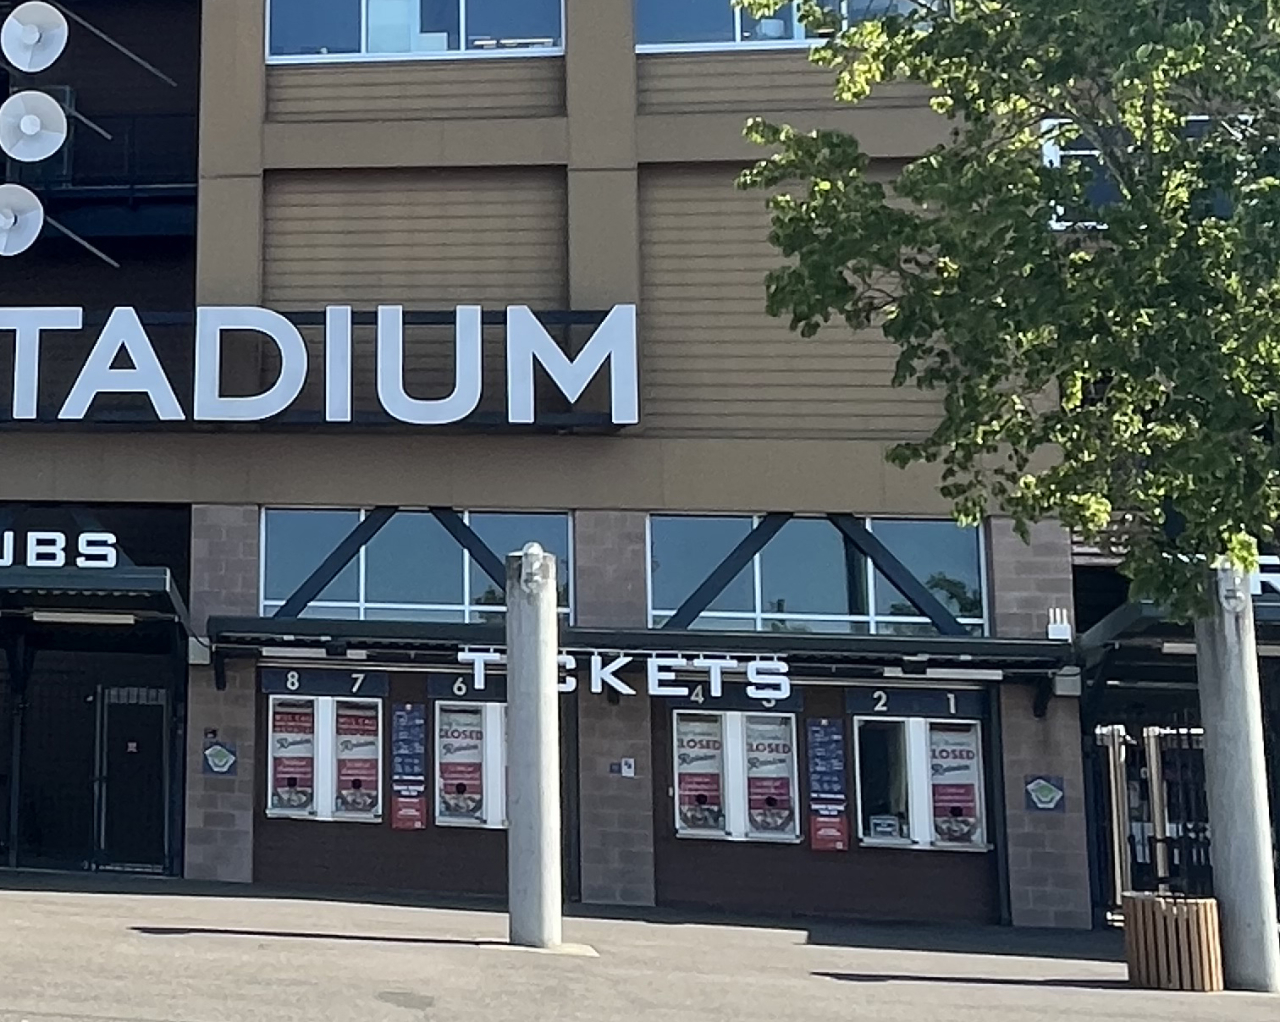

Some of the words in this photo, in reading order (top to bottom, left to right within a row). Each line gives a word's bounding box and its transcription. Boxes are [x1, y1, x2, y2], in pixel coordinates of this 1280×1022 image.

[286, 671, 299, 690] 8
[351, 673, 365, 693] 7
[457, 651, 791, 699] TKETS
[453, 677, 467, 696] 6
[690, 685, 705, 704] 4
[873, 690, 888, 711] 2
[947, 693, 956, 714] 1
[931, 748, 975, 760] LOSED
